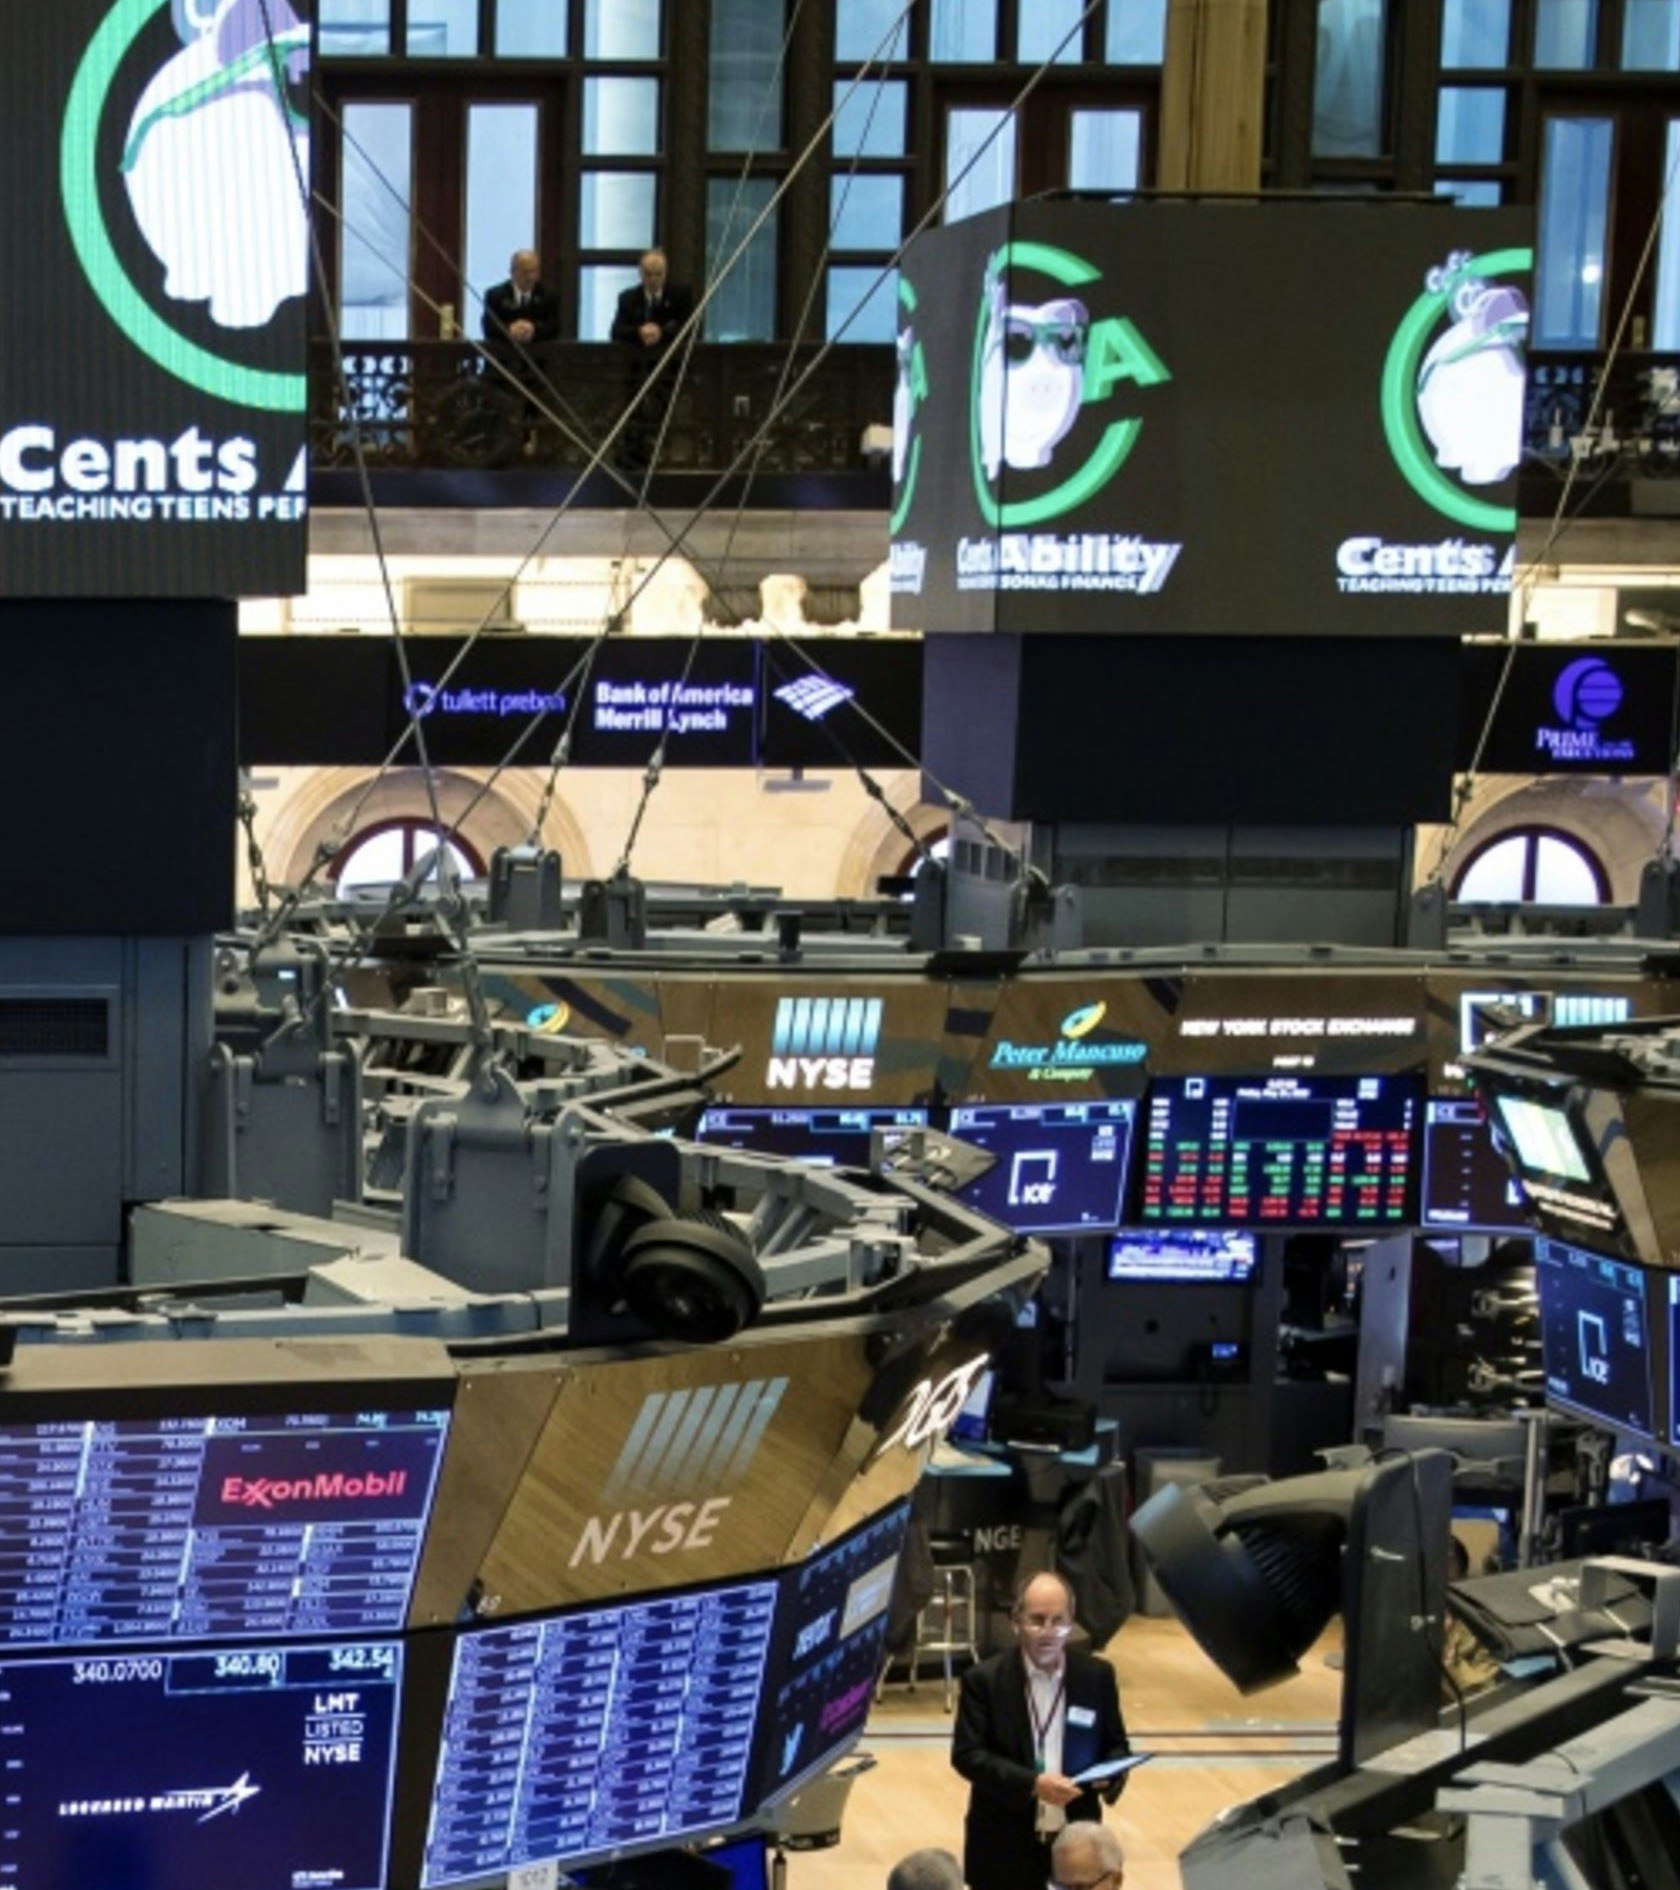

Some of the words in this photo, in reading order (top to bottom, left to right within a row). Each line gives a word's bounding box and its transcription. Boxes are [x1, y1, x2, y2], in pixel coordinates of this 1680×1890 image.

[0, 496, 153, 520] TEACHING
[156, 496, 250, 520] TEENS
[999, 535, 1172, 593] Ability
[1337, 536, 1497, 577] Cents
[442, 692, 498, 711] tullett
[500, 692, 566, 716] prebon
[596, 682, 645, 704] Bank
[646, 682, 669, 704] of
[672, 682, 753, 705] America
[595, 708, 663, 730] Merrill
[668, 708, 727, 734] Lynch
[1536, 726, 1599, 749] PRIME
[1180, 1018, 1220, 1036] NEW
[1222, 1018, 1268, 1036] YORK
[1270, 1018, 1324, 1036] STOCK
[1326, 1017, 1417, 1036] EXCHANGE
[991, 1041, 1051, 1067] Peter
[1053, 1040, 1147, 1065] Mancuso
[766, 1058, 876, 1090] NYSE
[220, 1471, 407, 1508] ExxonMobil
[568, 1496, 733, 1570] NYSE
[973, 1525, 1022, 1552] NGE
[73, 1661, 163, 1686] 340.0700
[314, 1694, 360, 1714] LMT
[304, 1718, 364, 1739] LISTED
[304, 1744, 361, 1763] NYSE
[59, 1799, 145, 1816] LOCKHEED
[149, 1794, 214, 1811] MARTIN
